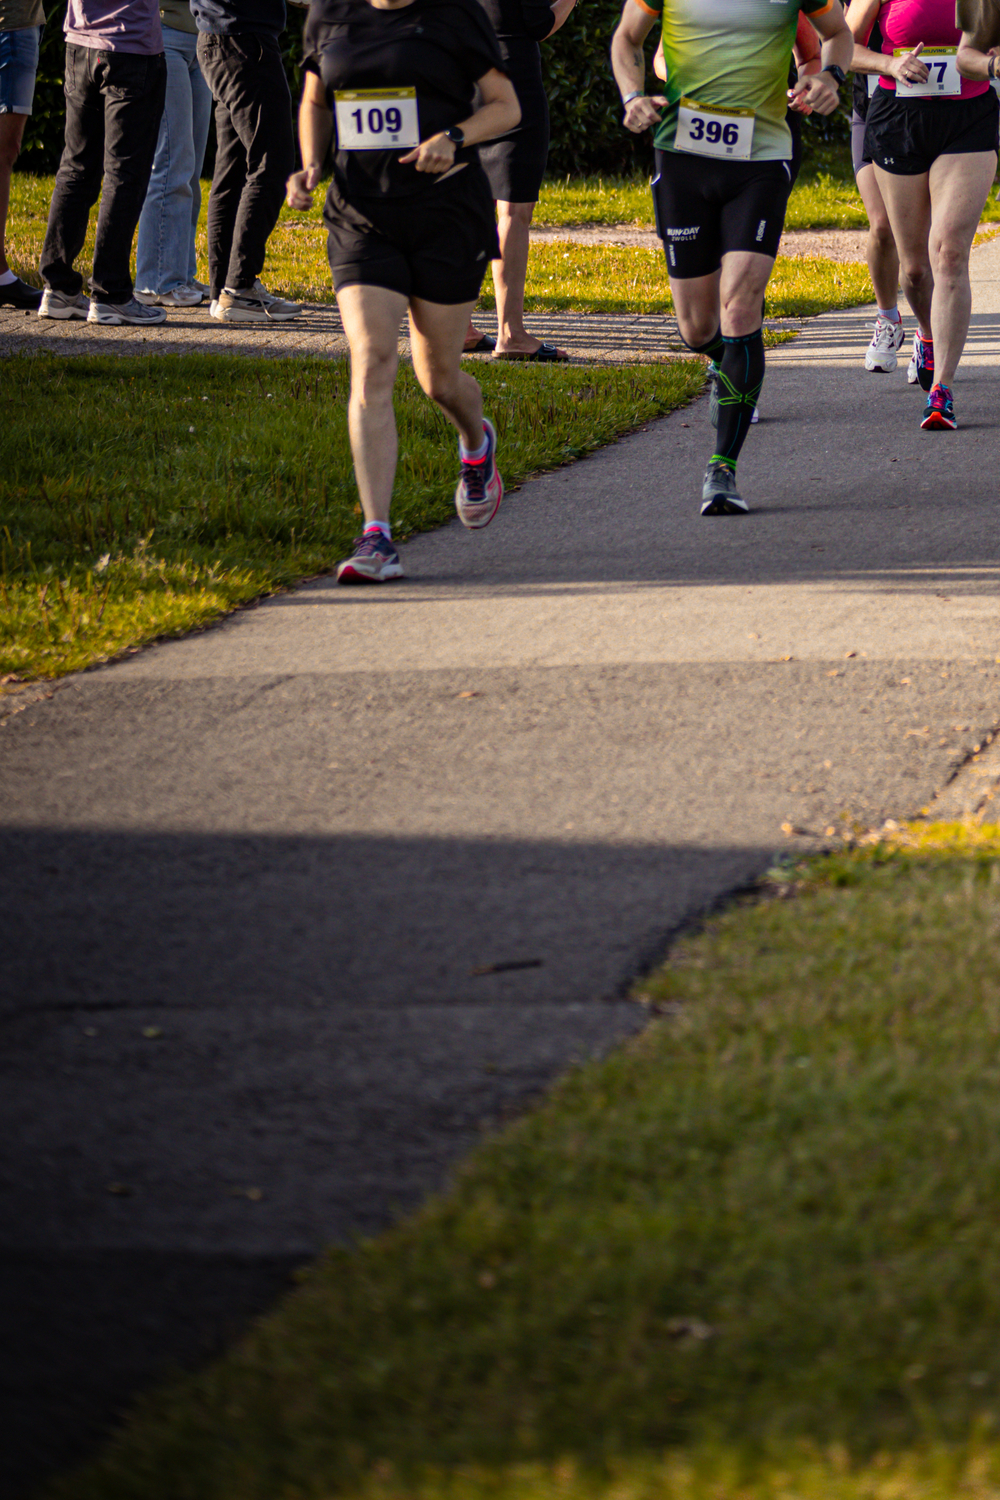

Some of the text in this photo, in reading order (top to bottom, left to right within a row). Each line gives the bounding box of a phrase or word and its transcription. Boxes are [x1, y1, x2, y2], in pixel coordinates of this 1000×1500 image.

[350, 107, 403, 135] 109
[688, 117, 740, 147] 396
[671, 234, 697, 242] ZWOLLE
